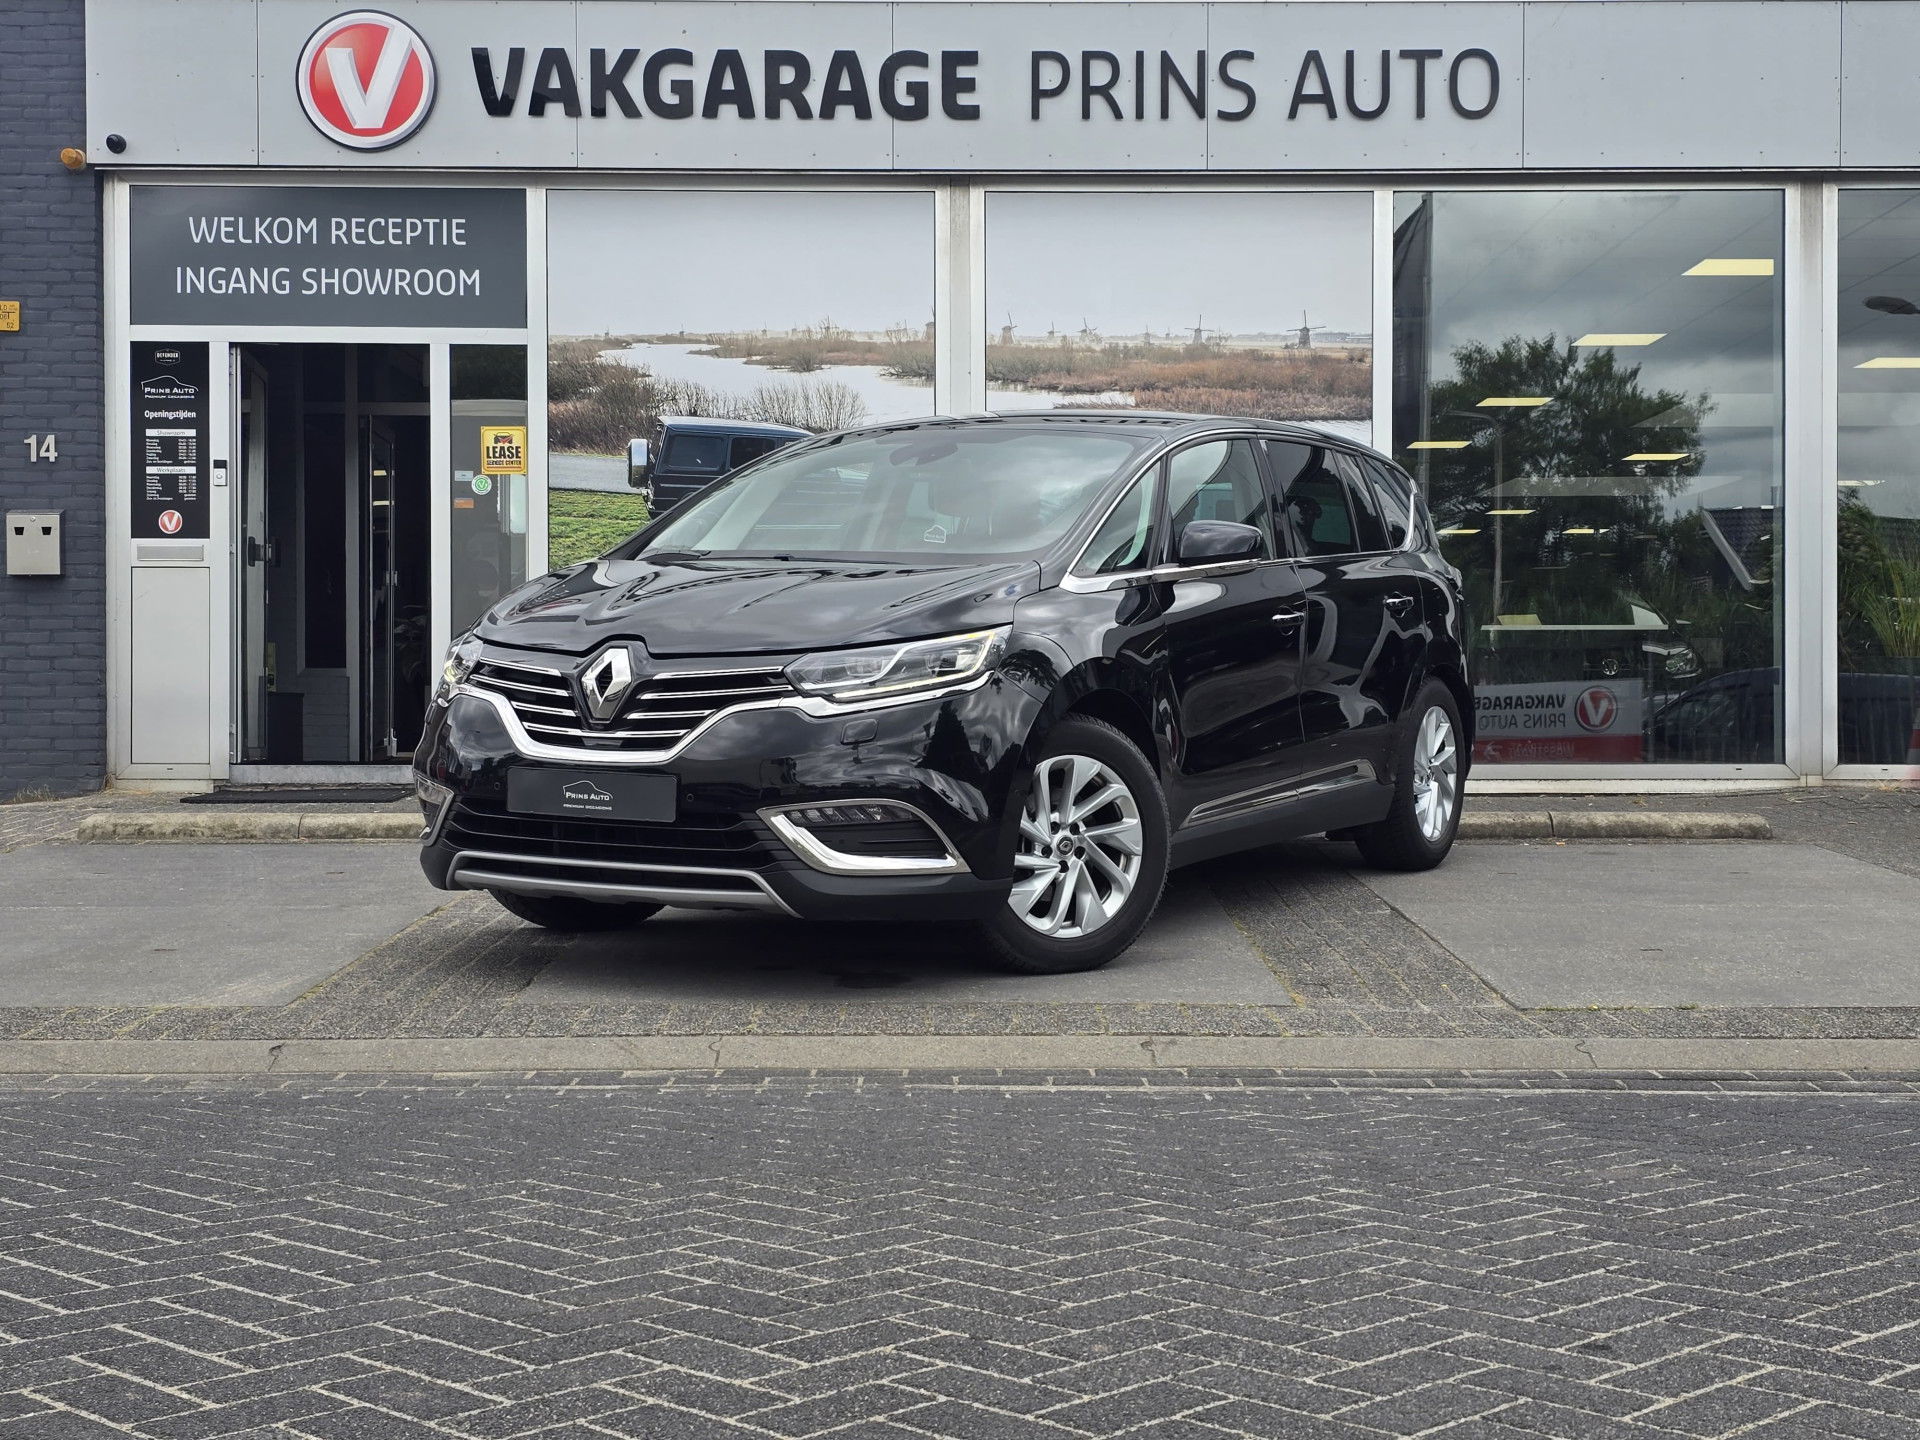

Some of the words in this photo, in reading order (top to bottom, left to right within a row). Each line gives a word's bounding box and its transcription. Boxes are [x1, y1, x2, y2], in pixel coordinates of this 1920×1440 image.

[325, 27, 414, 129] V
[471, 47, 980, 121] VAKGARAGE
[1030, 48, 1257, 122] PRINS
[1287, 47, 1500, 121] AUTO
[188, 216, 318, 244] WELKOM
[330, 217, 467, 245] RECEPTIE
[176, 266, 290, 294] INGANG
[301, 267, 481, 296] SHOWROOM
[144, 410, 197, 420] Openingstijden
[23, 433, 58, 463] 14
[486, 446, 522, 459] LEASE
[566, 792, 588, 800] PRINS
